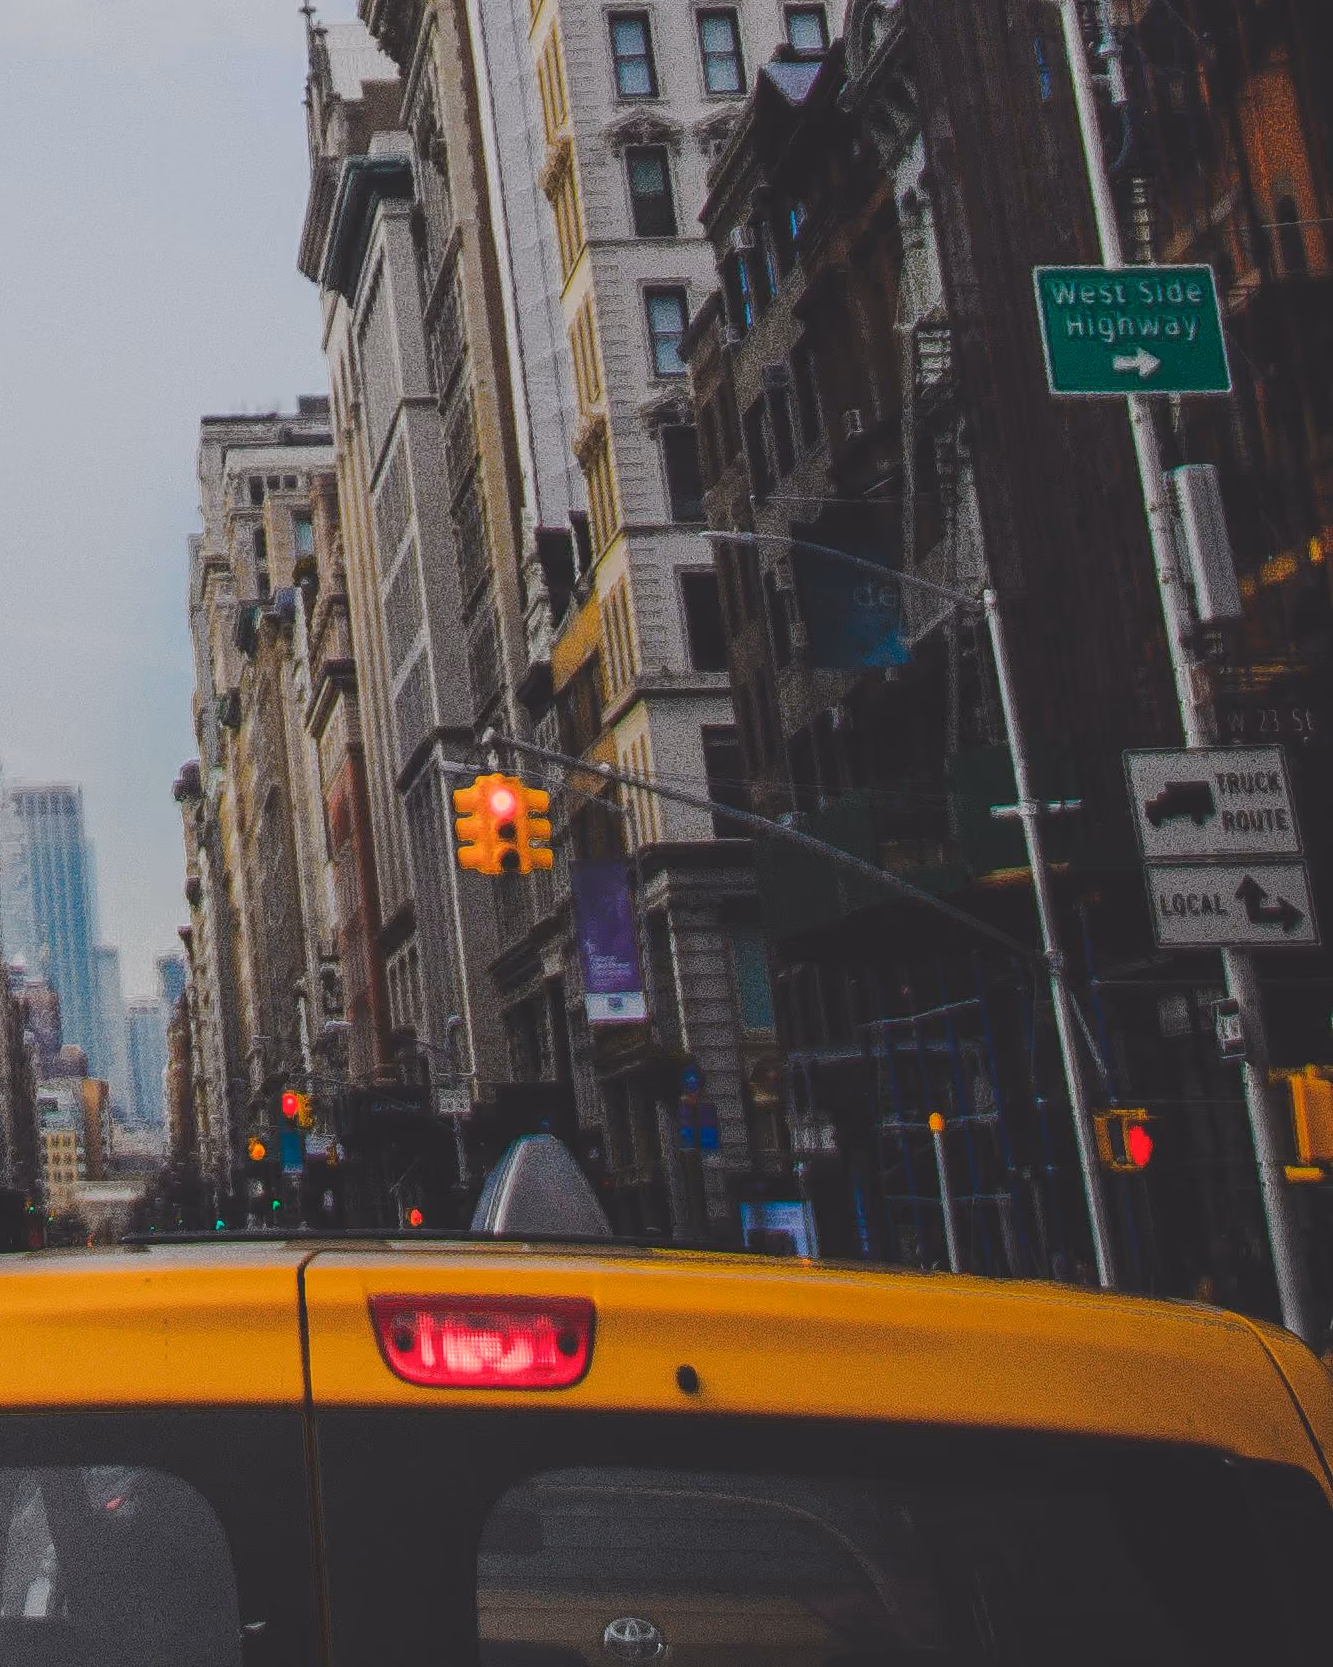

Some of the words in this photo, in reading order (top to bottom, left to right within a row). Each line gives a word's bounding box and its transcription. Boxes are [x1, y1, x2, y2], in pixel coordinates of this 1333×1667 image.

[1051, 281, 1126, 305] West
[1138, 279, 1203, 304] Side
[1065, 311, 1198, 343] Highway
[1256, 708, 1281, 733] 23
[1291, 707, 1315, 733] St
[1215, 772, 1283, 795] TRUCK
[1222, 809, 1290, 833] ROUTE
[1159, 893, 1229, 917] LOCAL
